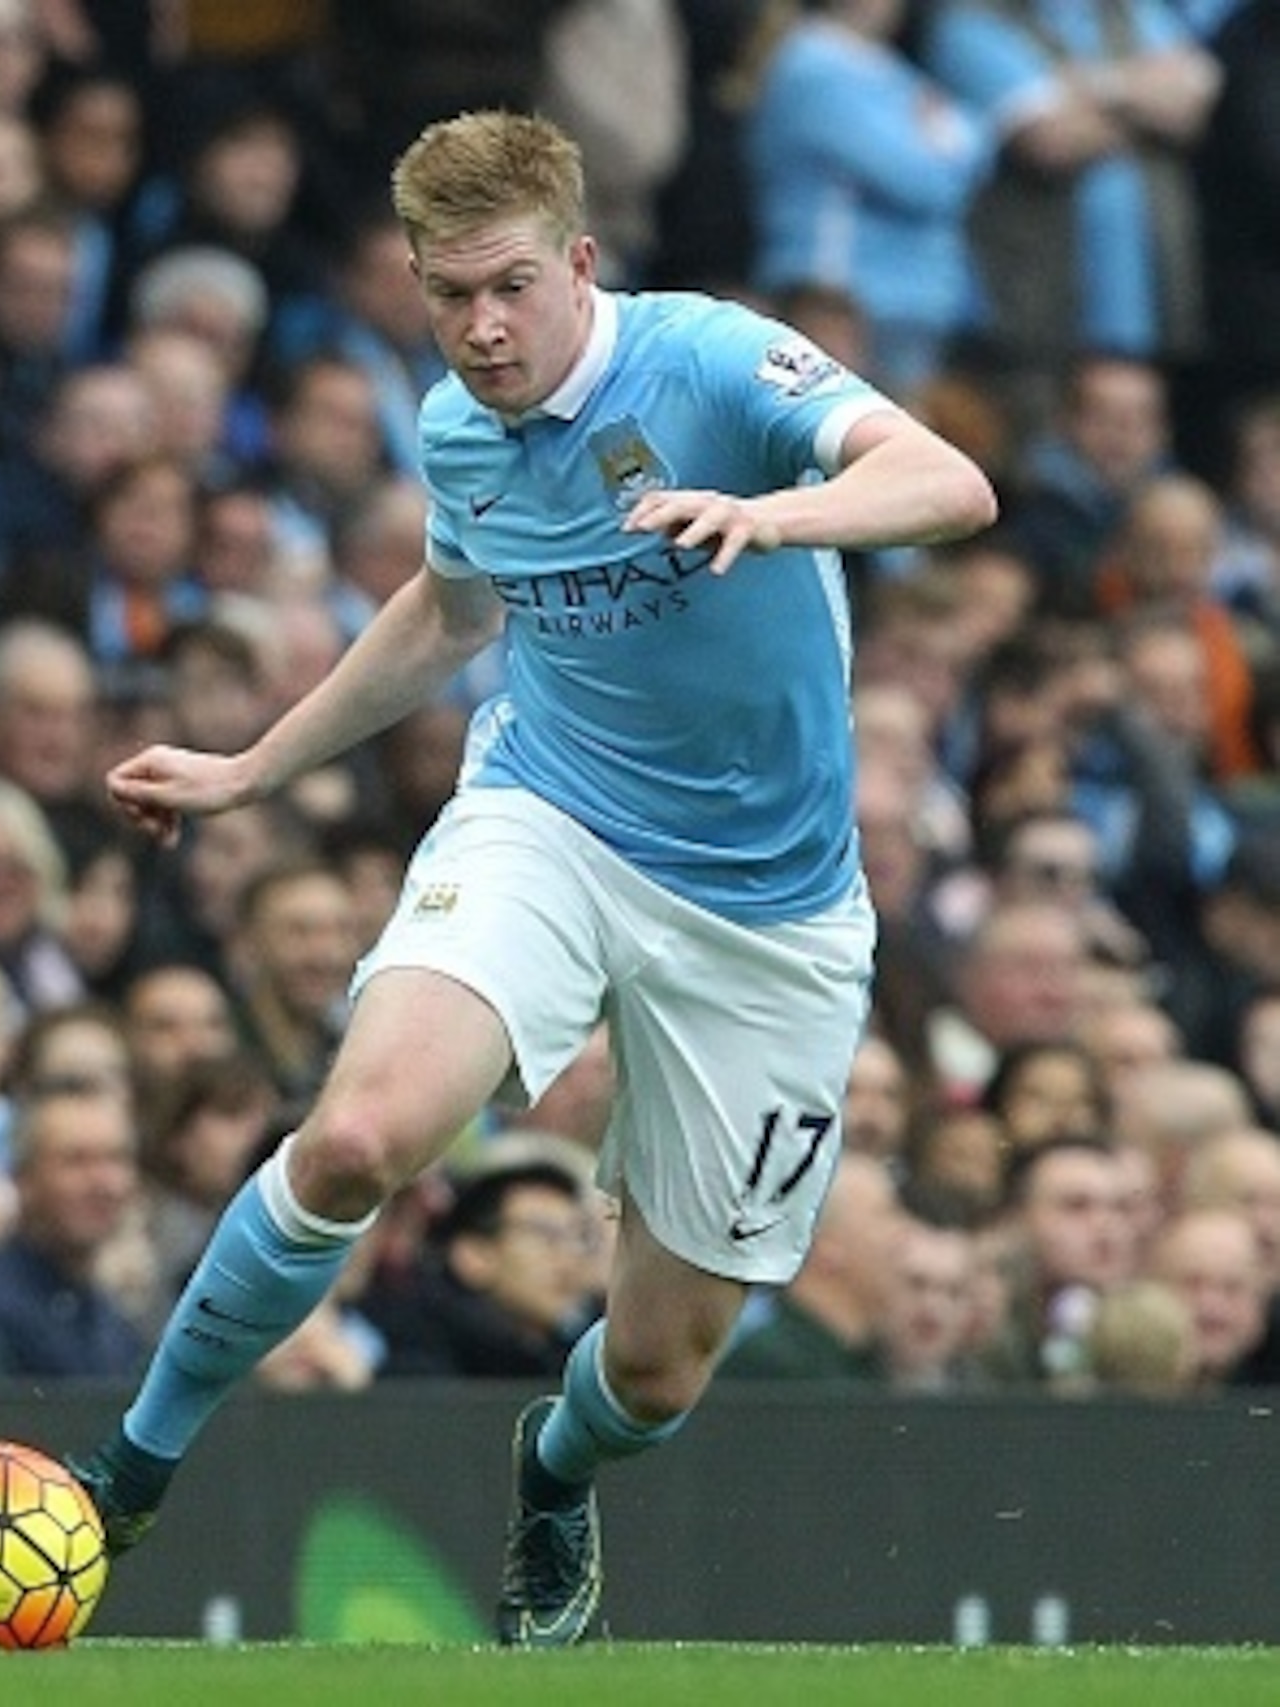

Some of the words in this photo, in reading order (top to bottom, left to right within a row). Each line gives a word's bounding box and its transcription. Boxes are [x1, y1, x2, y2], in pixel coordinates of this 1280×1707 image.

[491, 546, 718, 606] ETIHAD
[538, 590, 689, 639] AIRWAYS
[744, 1110, 834, 1202] 17
